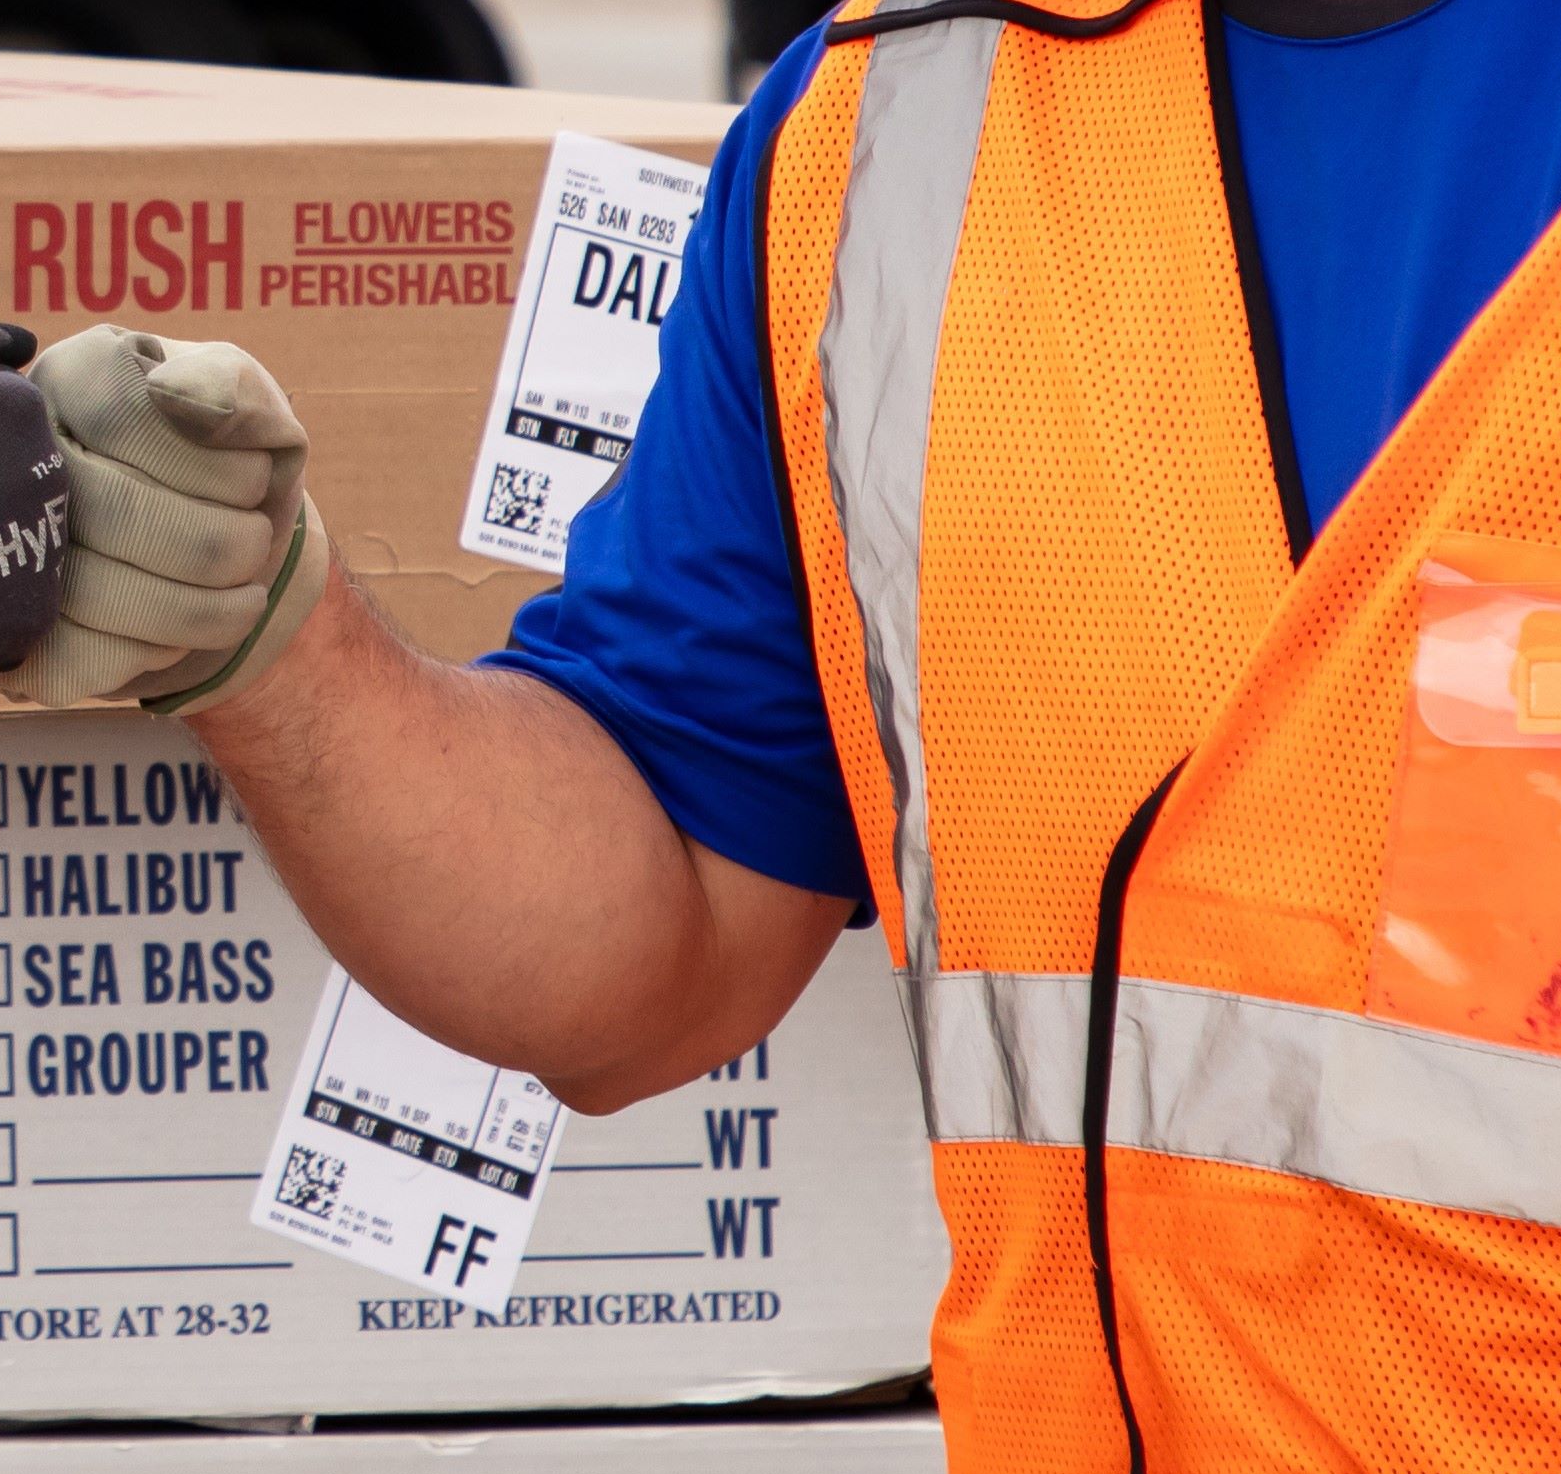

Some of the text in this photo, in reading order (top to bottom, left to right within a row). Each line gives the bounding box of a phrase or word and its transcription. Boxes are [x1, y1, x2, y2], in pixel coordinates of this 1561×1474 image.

[294, 200, 515, 245] FLOWERS
[559, 192, 677, 245] 526 SAN 8293
[13, 199, 244, 313] RUSH
[259, 262, 515, 307] PERISHABL
[573, 240, 670, 328] DAL
[16, 761, 244, 827] YELLOW
[23, 850, 244, 917] HALIBUT
[23, 939, 274, 1008] SEA BASS
[27, 1030, 268, 1097] GROUPER
[704, 1107, 777, 1170] WT
[424, 1213, 498, 1288] FF
[707, 1197, 779, 1259] WT
[112, 1306, 163, 1338] AT
[176, 1302, 270, 1336] 28-32
[358, 1288, 782, 1332] KEEP REFRIGERATED
